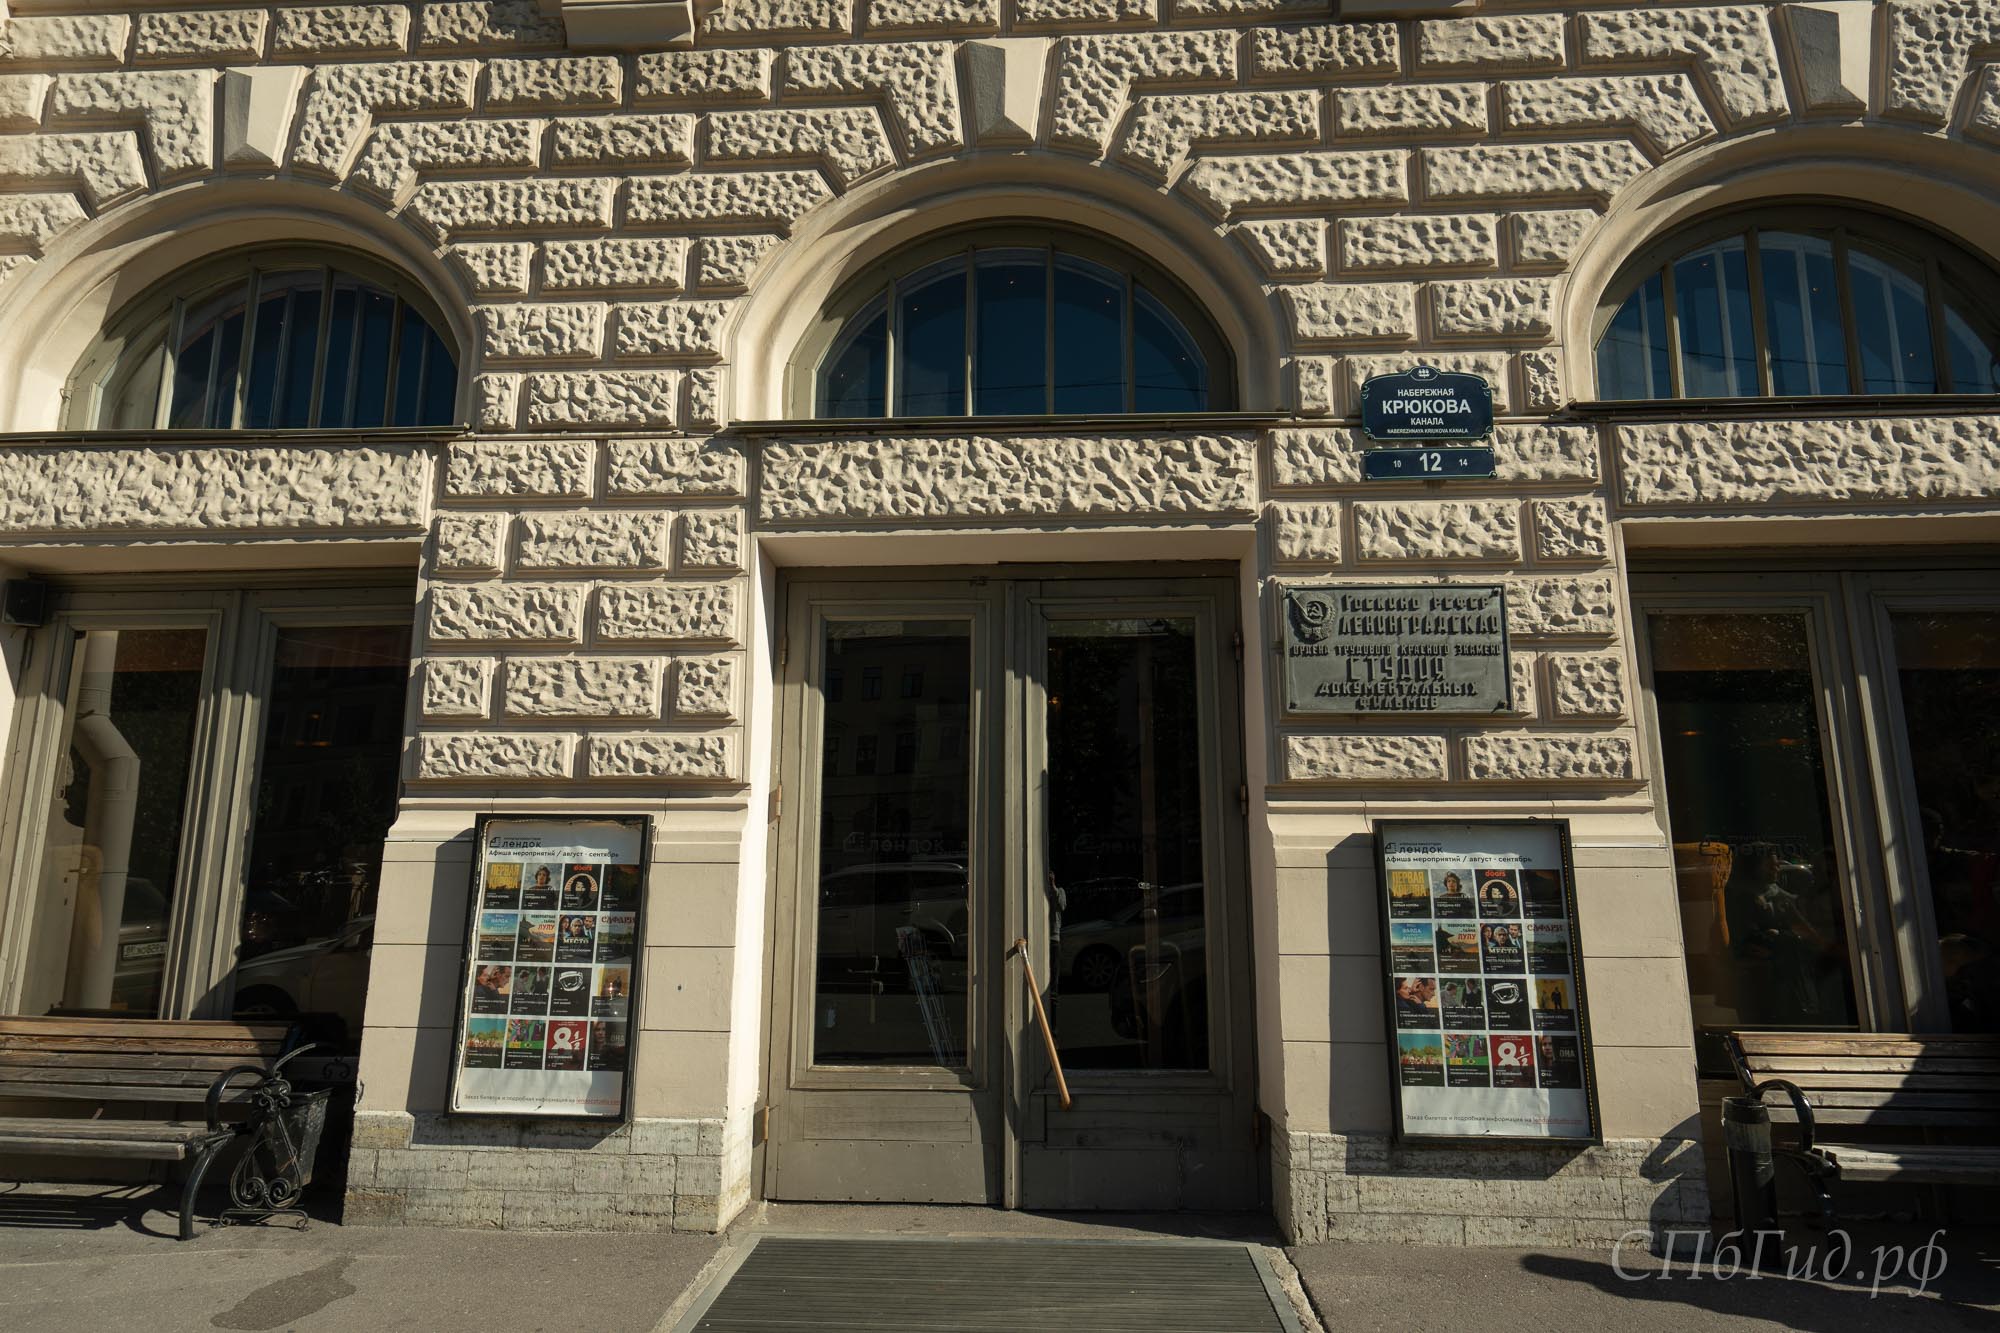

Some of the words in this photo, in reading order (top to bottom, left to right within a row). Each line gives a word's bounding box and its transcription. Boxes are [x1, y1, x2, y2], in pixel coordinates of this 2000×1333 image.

[1397, 388, 1454, 397] НАБЕРЕЖНАЯ
[1382, 399, 1472, 414] КРЮКОВА
[1410, 417, 1444, 426] КАНАЛА
[1393, 460, 1402, 468] 10
[1419, 453, 1442, 472] 12
[1430, 596, 1489, 612] РСФСР
[1338, 615, 1500, 635] ЛЕНИНГРАДСКАЯ
[1290, 645, 1329, 657] ОРДЕНА
[1335, 645, 1392, 657] ТРУДОВОГО
[1398, 645, 1449, 657] КРАСНОГО
[1455, 644, 1501, 656] ЗНАМЕНИ
[1346, 656, 1446, 682] СТУДИЯ
[1316, 682, 1478, 697] ДОКУМЕНТАЛЬНЫХ
[1356, 696, 1440, 710] ФИЛЬМОВ
[501, 840, 542, 848] лендок
[1399, 846, 1444, 854] лендок
[488, 850, 512, 858] Афиша
[513, 850, 556, 859] мероприятий
[1386, 855, 1411, 864] Афиша
[1413, 855, 1461, 864] мероприятий
[1469, 856, 1492, 864] август
[1498, 855, 1533, 864] сентябрь
[491, 863, 520, 876] ПЕРВАЯ
[1484, 870, 1507, 878] doors
[1391, 871, 1425, 884] ПЕРВАЯ
